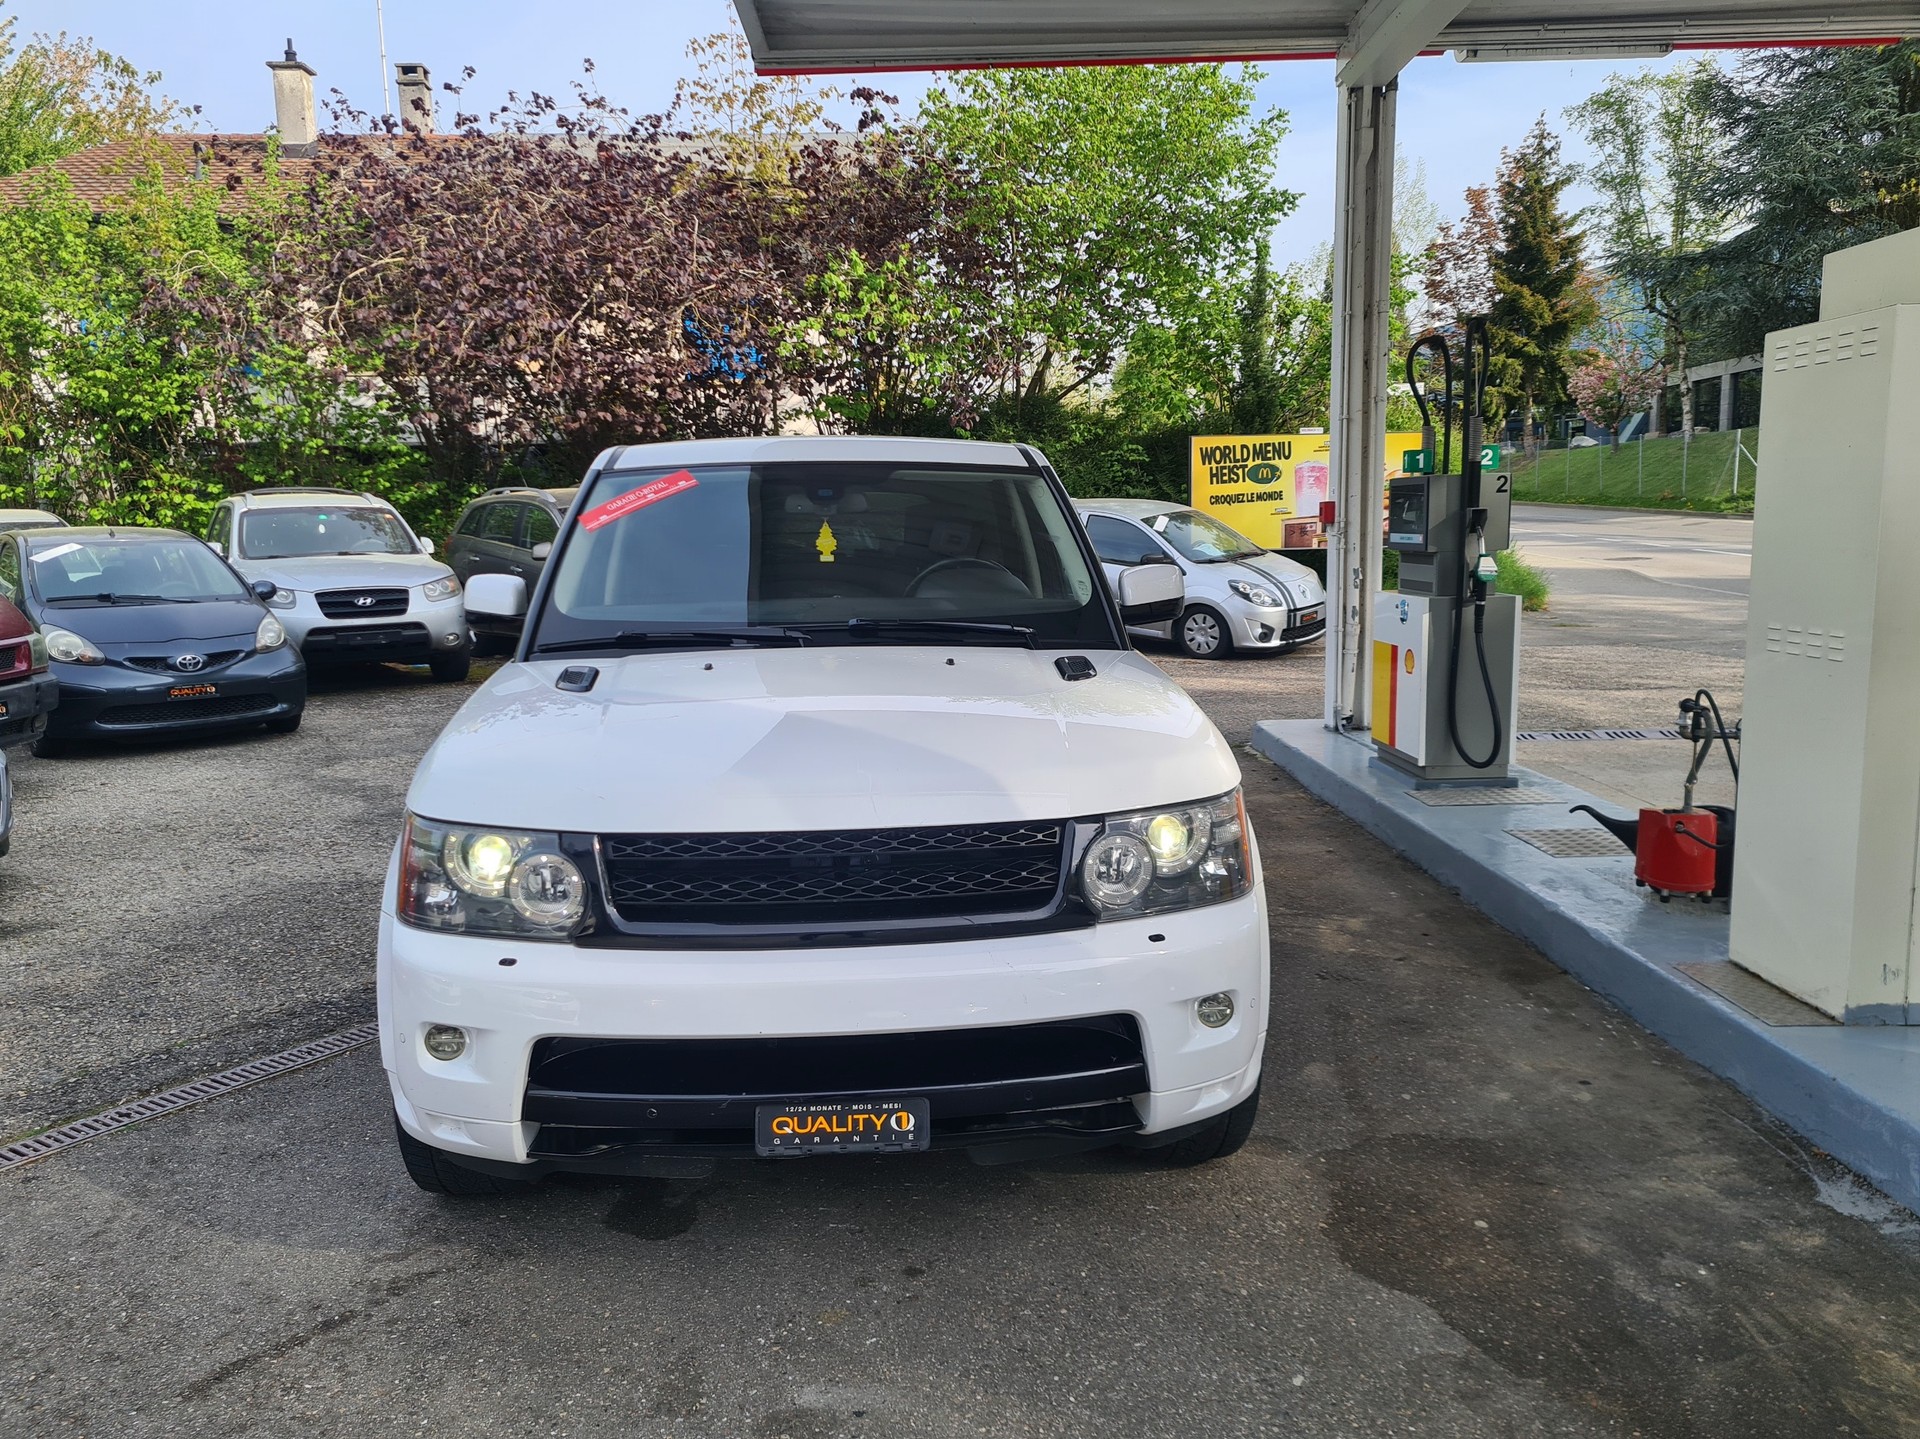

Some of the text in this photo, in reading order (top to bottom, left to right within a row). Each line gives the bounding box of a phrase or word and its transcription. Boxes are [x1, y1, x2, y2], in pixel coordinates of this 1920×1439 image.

[1200, 441, 1291, 465] WORLD MENU
[1416, 453, 1424, 468] 1
[1481, 449, 1493, 465] 2
[1209, 464, 1248, 485] HEIST
[1496, 475, 1508, 493] 2
[1209, 490, 1283, 506] CROQUEZ LE MONDE
[772, 1113, 888, 1134] QUALITY
[773, 1133, 914, 1145] GARANTIE
